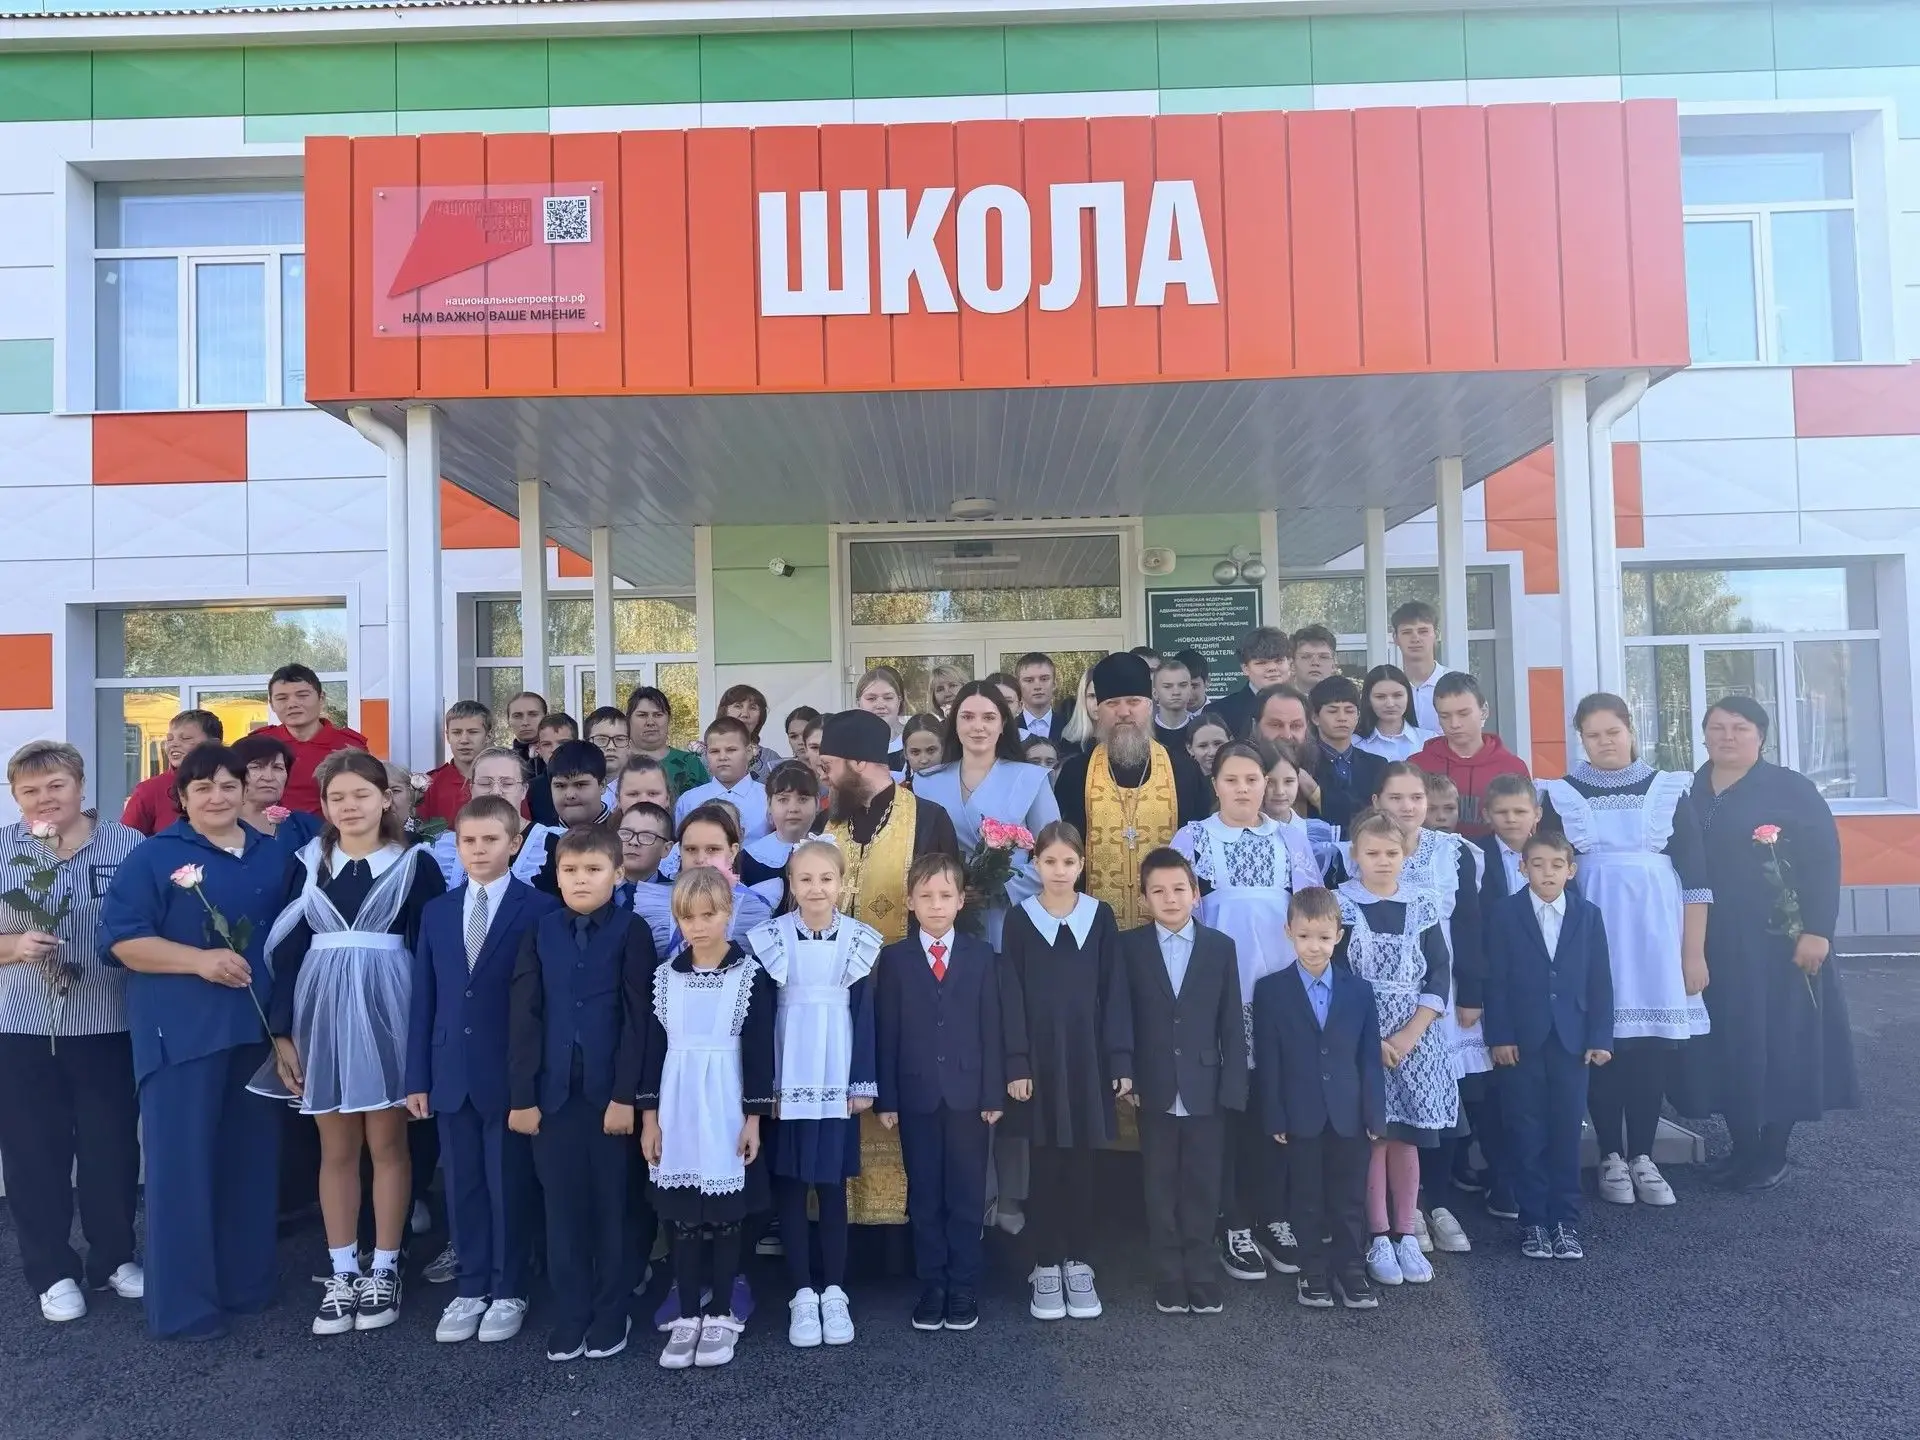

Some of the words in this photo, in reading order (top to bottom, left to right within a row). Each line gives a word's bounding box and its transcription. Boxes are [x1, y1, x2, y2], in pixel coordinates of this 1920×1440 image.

[759, 180, 1219, 316] ШКОЛА
[445, 293, 586, 307] национальныепроекты.рф
[402, 312, 433, 324] НАМ
[436, 311, 486, 323] ВАЖНО
[489, 310, 527, 321] ВАШЕ
[530, 309, 586, 320] МНЕНИЕ
